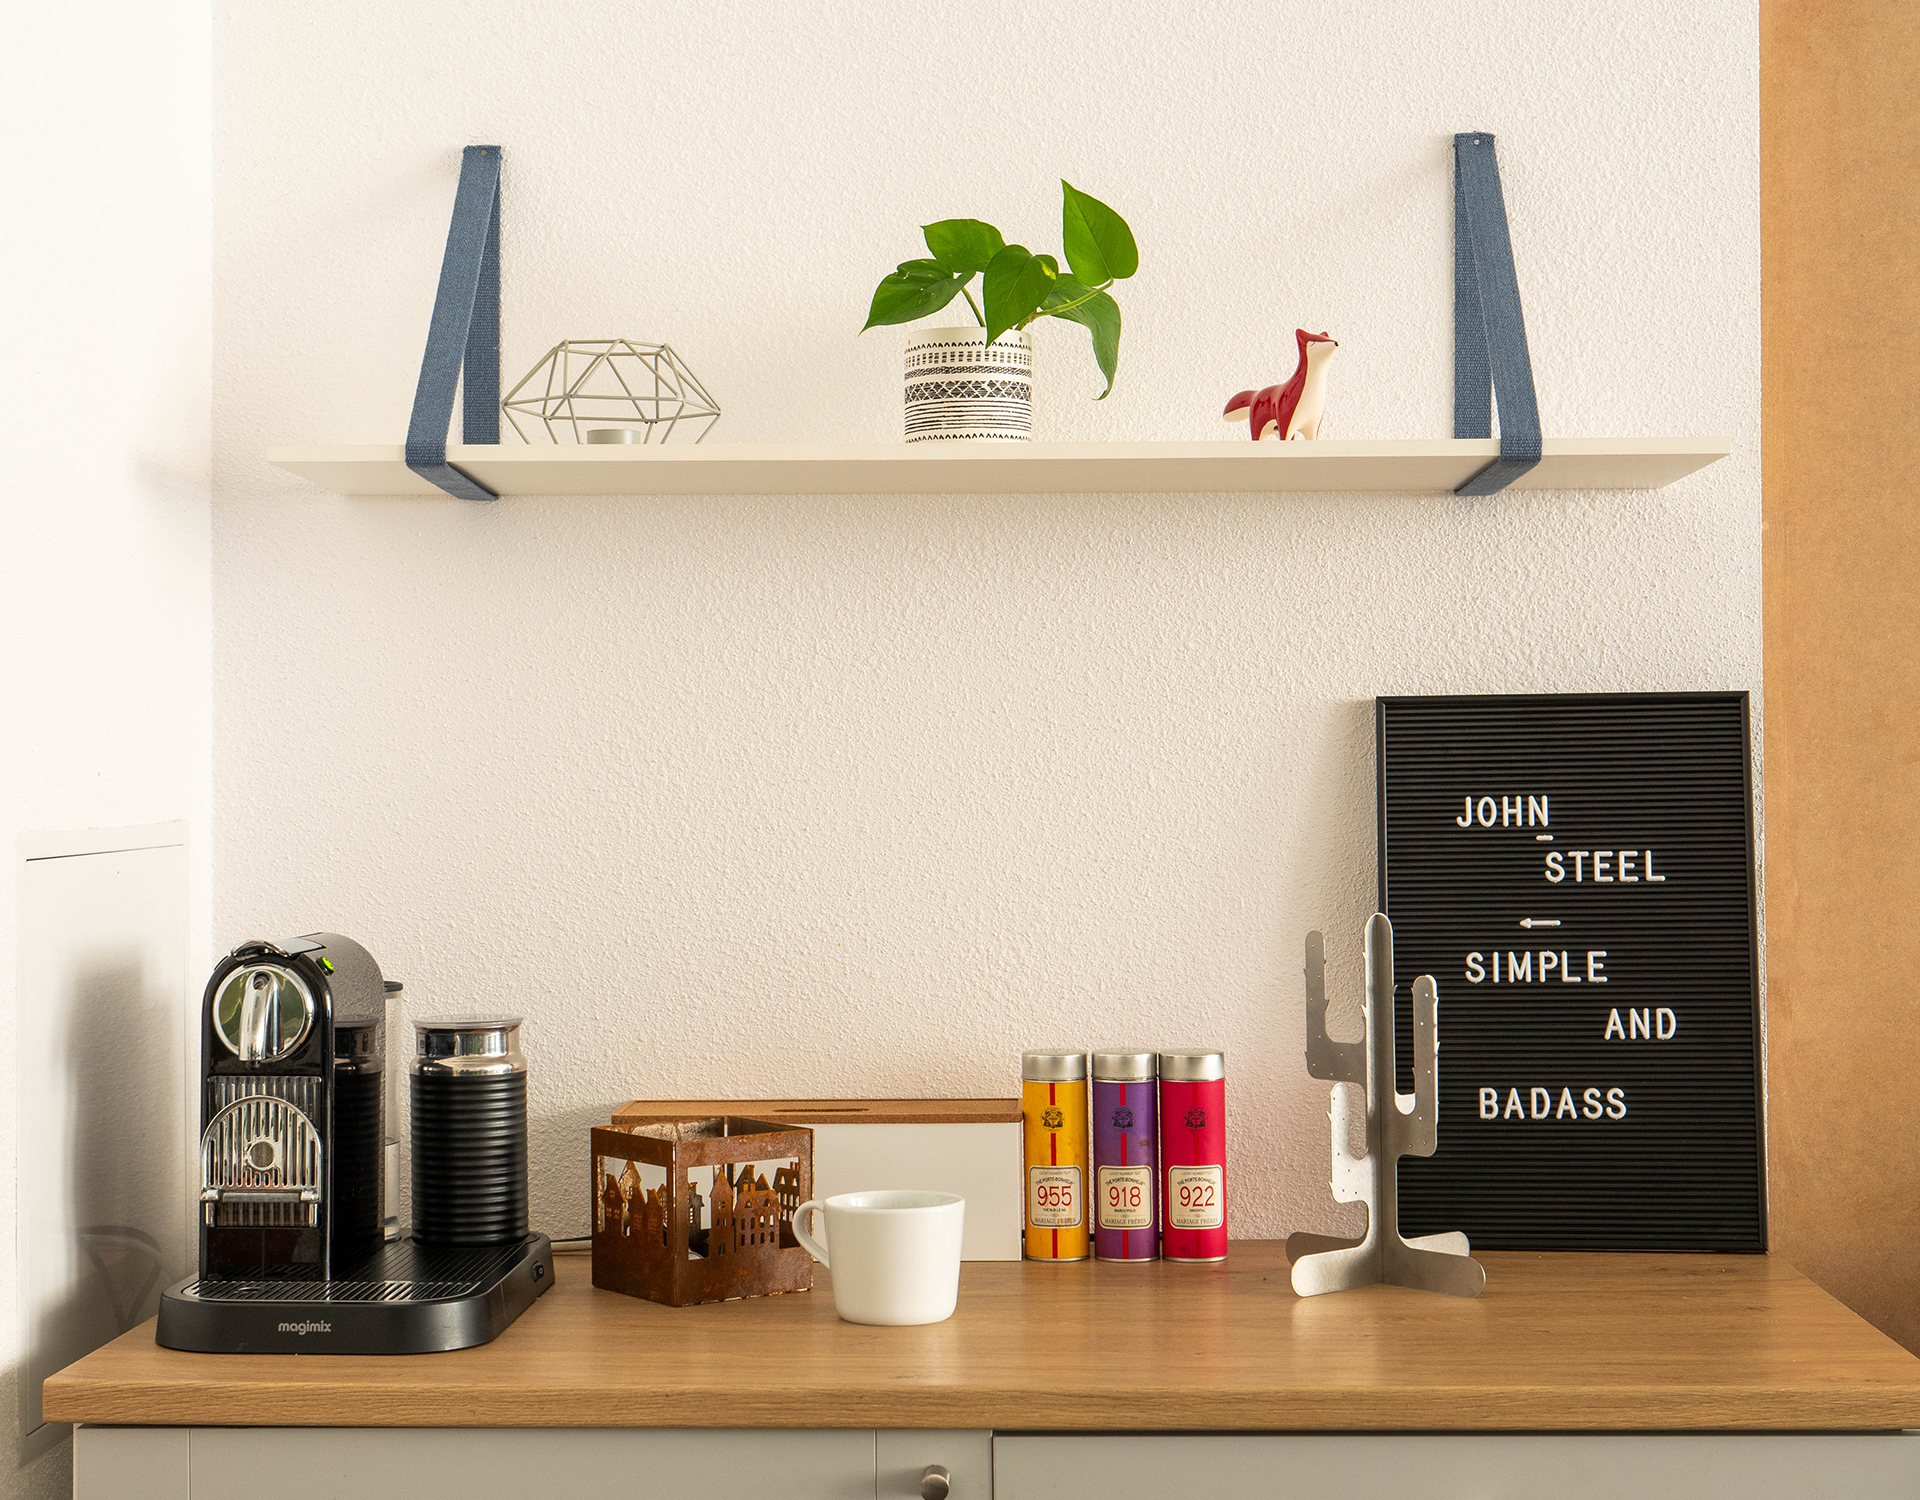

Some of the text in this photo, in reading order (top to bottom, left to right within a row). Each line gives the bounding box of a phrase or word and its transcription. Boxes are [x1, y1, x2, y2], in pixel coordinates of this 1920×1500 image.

[1456, 795, 1549, 828] JOHN
[1544, 850, 1666, 884] STEEL
[1465, 950, 1608, 984] SIMPLE
[1604, 1007, 1677, 1041] AND
[1479, 1086, 1627, 1121] BADASS
[1037, 1185, 1072, 1207] 955
[1109, 1186, 1141, 1207] 918
[1180, 1185, 1215, 1207] 922
[278, 1320, 332, 1336] magimix
